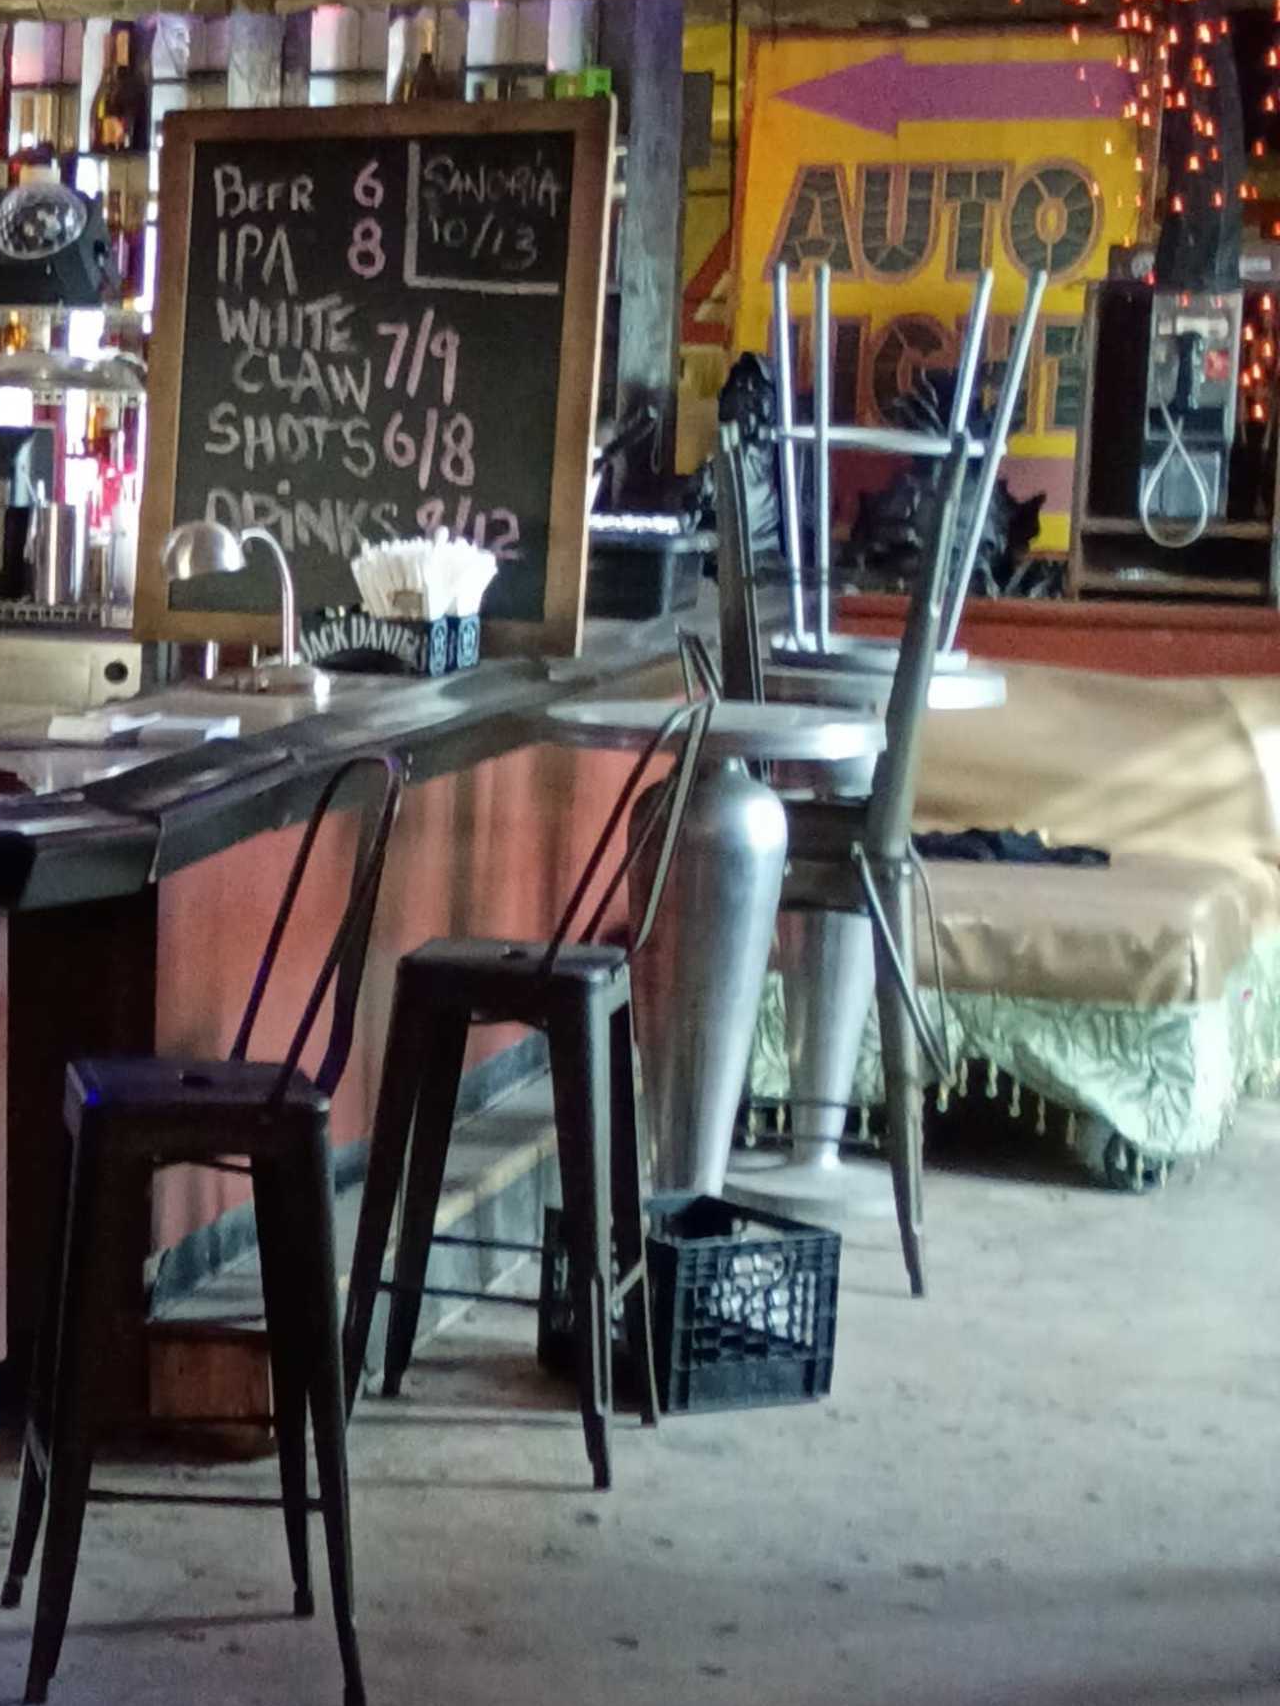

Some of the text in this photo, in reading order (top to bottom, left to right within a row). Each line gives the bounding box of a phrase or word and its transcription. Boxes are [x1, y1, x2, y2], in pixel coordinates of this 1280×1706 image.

[352, 158, 386, 210] 6
[764, 160, 1107, 283] AUTO
[216, 216, 387, 296] IPA 8
[215, 293, 461, 407] WHITE 7/9
[231, 349, 373, 415] CLAW
[204, 401, 476, 491] SHOTS 6/8
[299, 619, 350, 665] JACK
